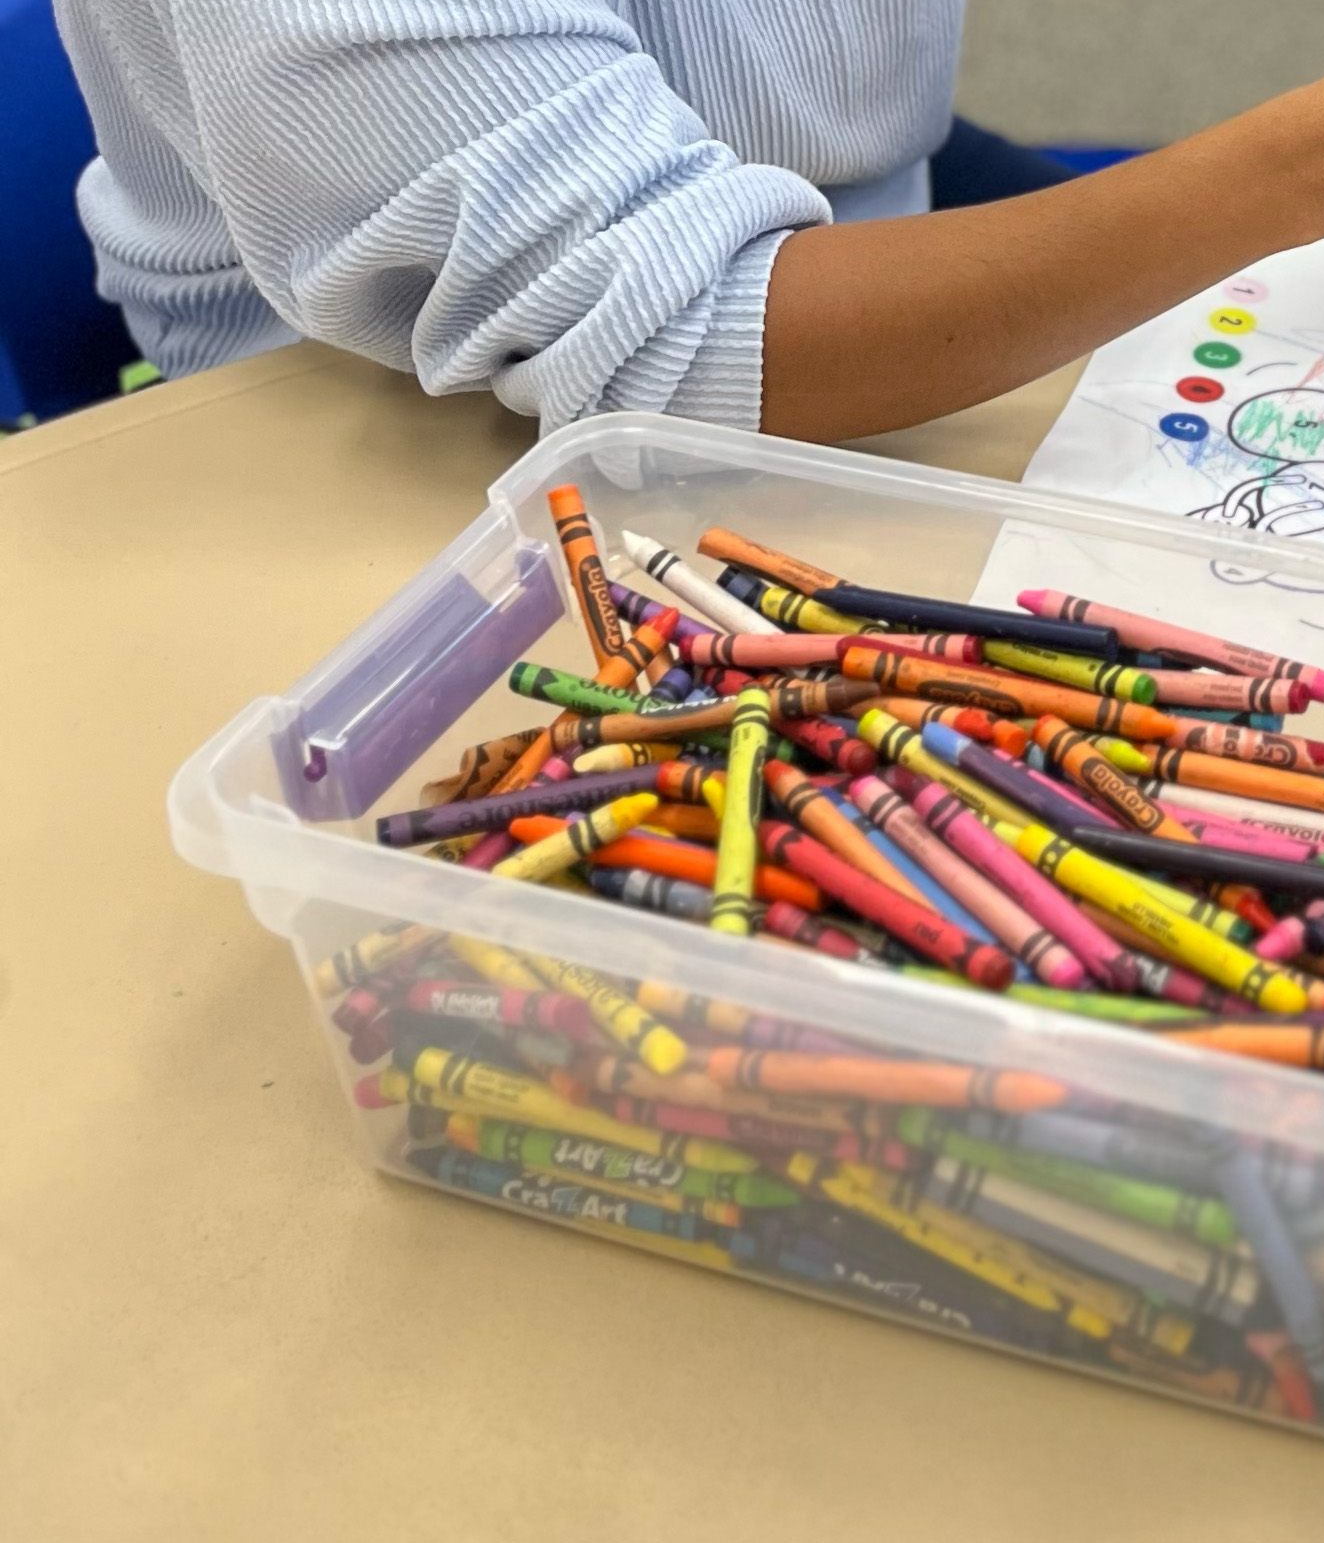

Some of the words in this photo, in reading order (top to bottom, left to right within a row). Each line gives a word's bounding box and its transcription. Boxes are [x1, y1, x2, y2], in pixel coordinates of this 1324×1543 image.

[1219, 315, 1243, 326] 2
[1205, 351, 1229, 362] 3
[1173, 420, 1198, 433] 5
[585, 566, 627, 655] Crayola
[1089, 760, 1160, 830] Crayola
